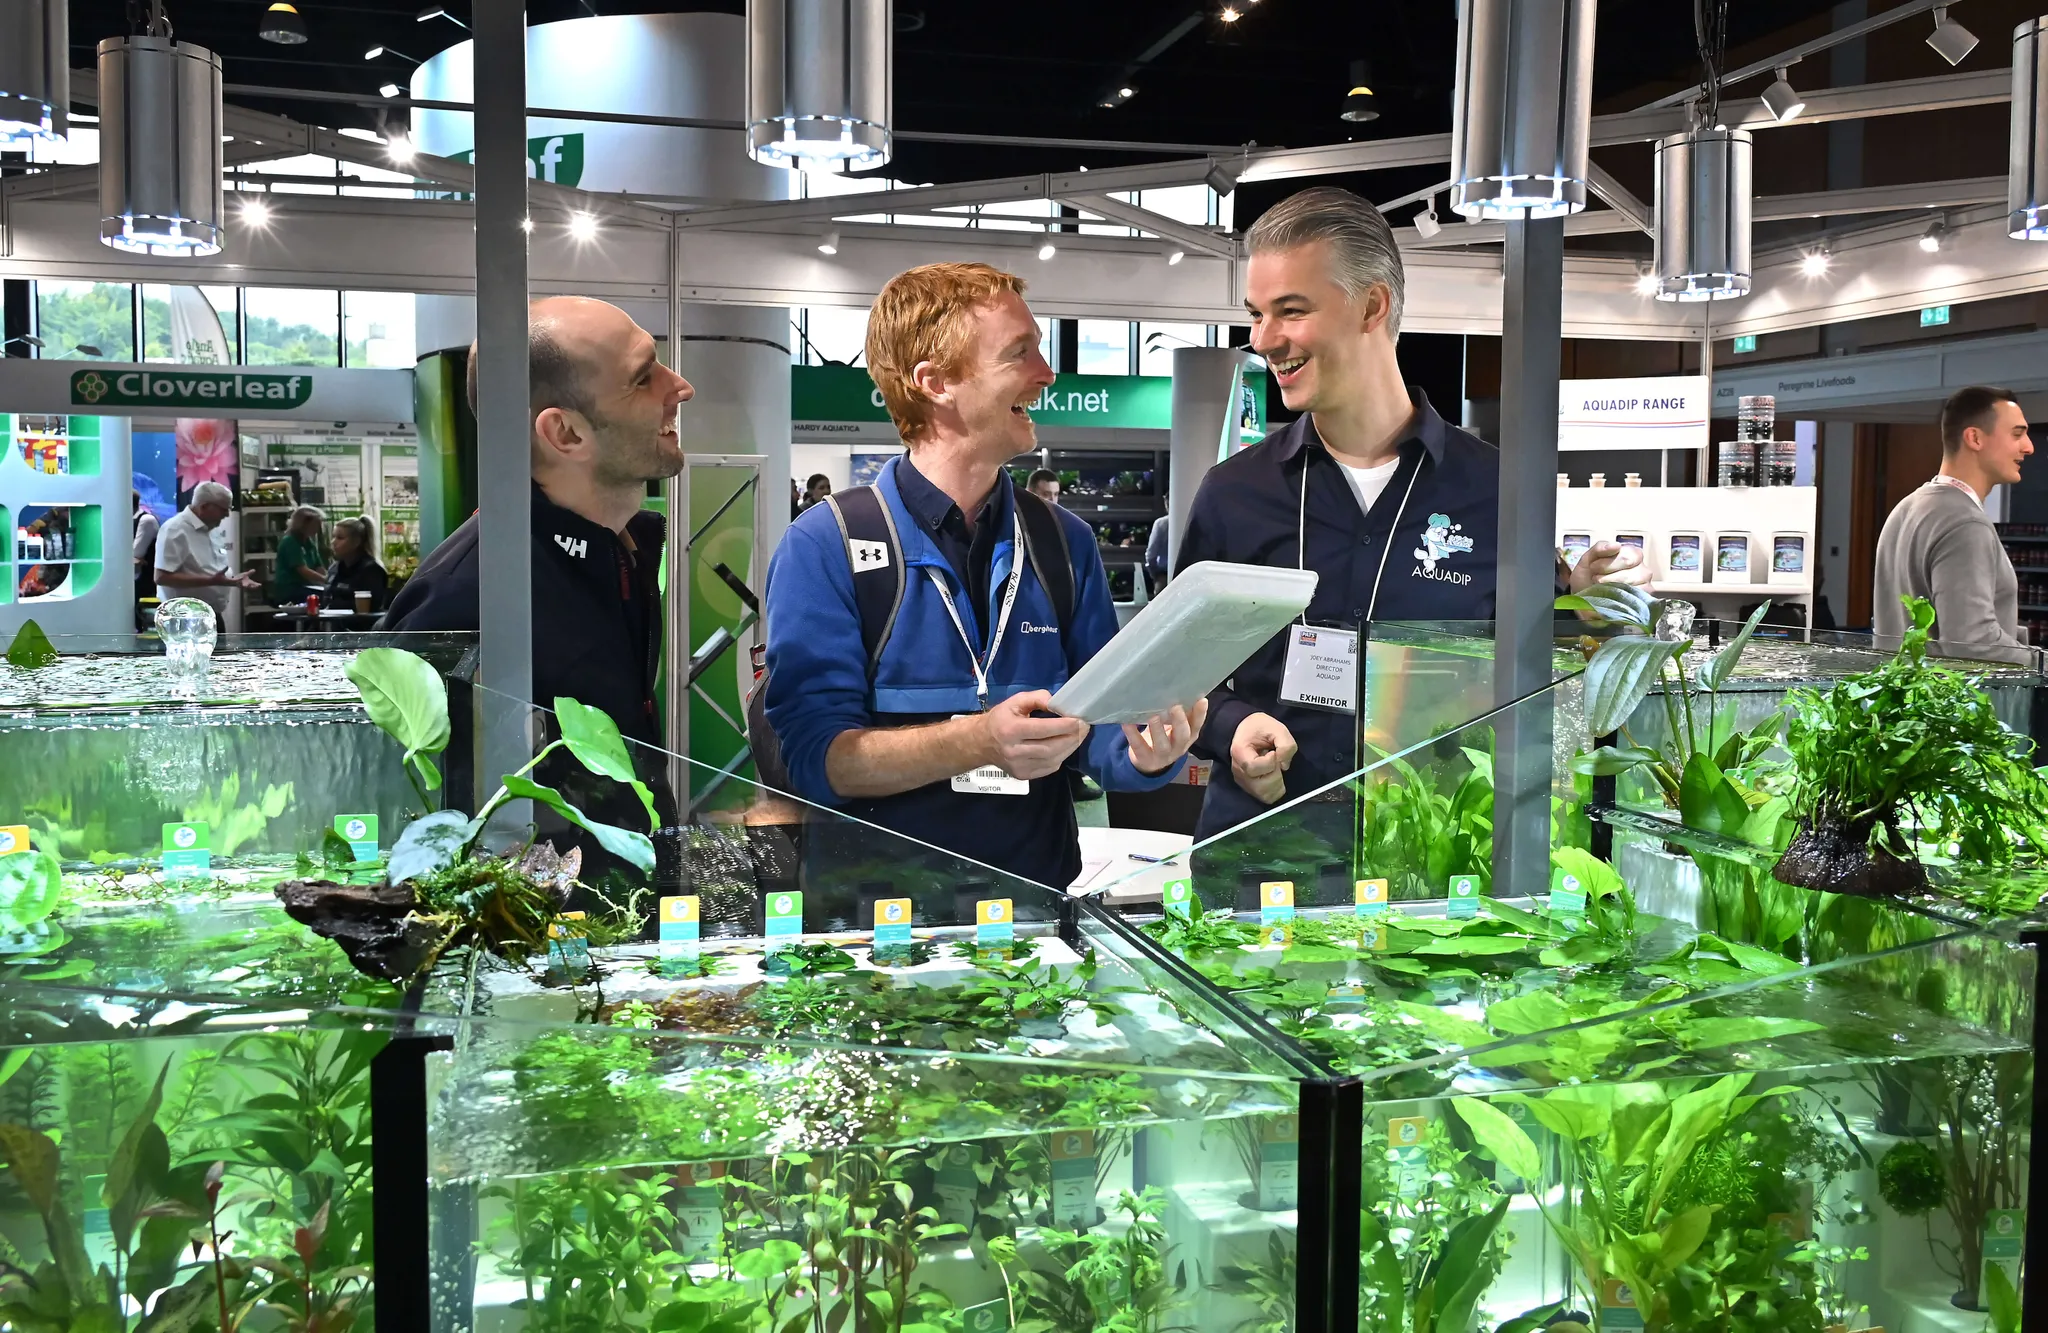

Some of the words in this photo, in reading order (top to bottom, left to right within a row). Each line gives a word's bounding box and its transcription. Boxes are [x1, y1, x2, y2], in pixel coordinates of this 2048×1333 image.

[116, 372, 302, 400] Cloverleaf
[1778, 379, 1815, 393] Peregrine
[1816, 375, 1856, 389] Livefoods
[1583, 398, 1639, 411] AQUADIP
[1643, 397, 1686, 410] RANGE
[822, 424, 860, 432] AQUATICA
[1411, 565, 1472, 586] AQUADIP
[1029, 622, 1058, 634] berghaus
[1323, 657, 1351, 665] ABRAHAMS
[1316, 665, 1343, 673] DIRECTOR
[1316, 673, 1341, 681] AQUADIP
[1300, 693, 1348, 708] EXHIBITOR
